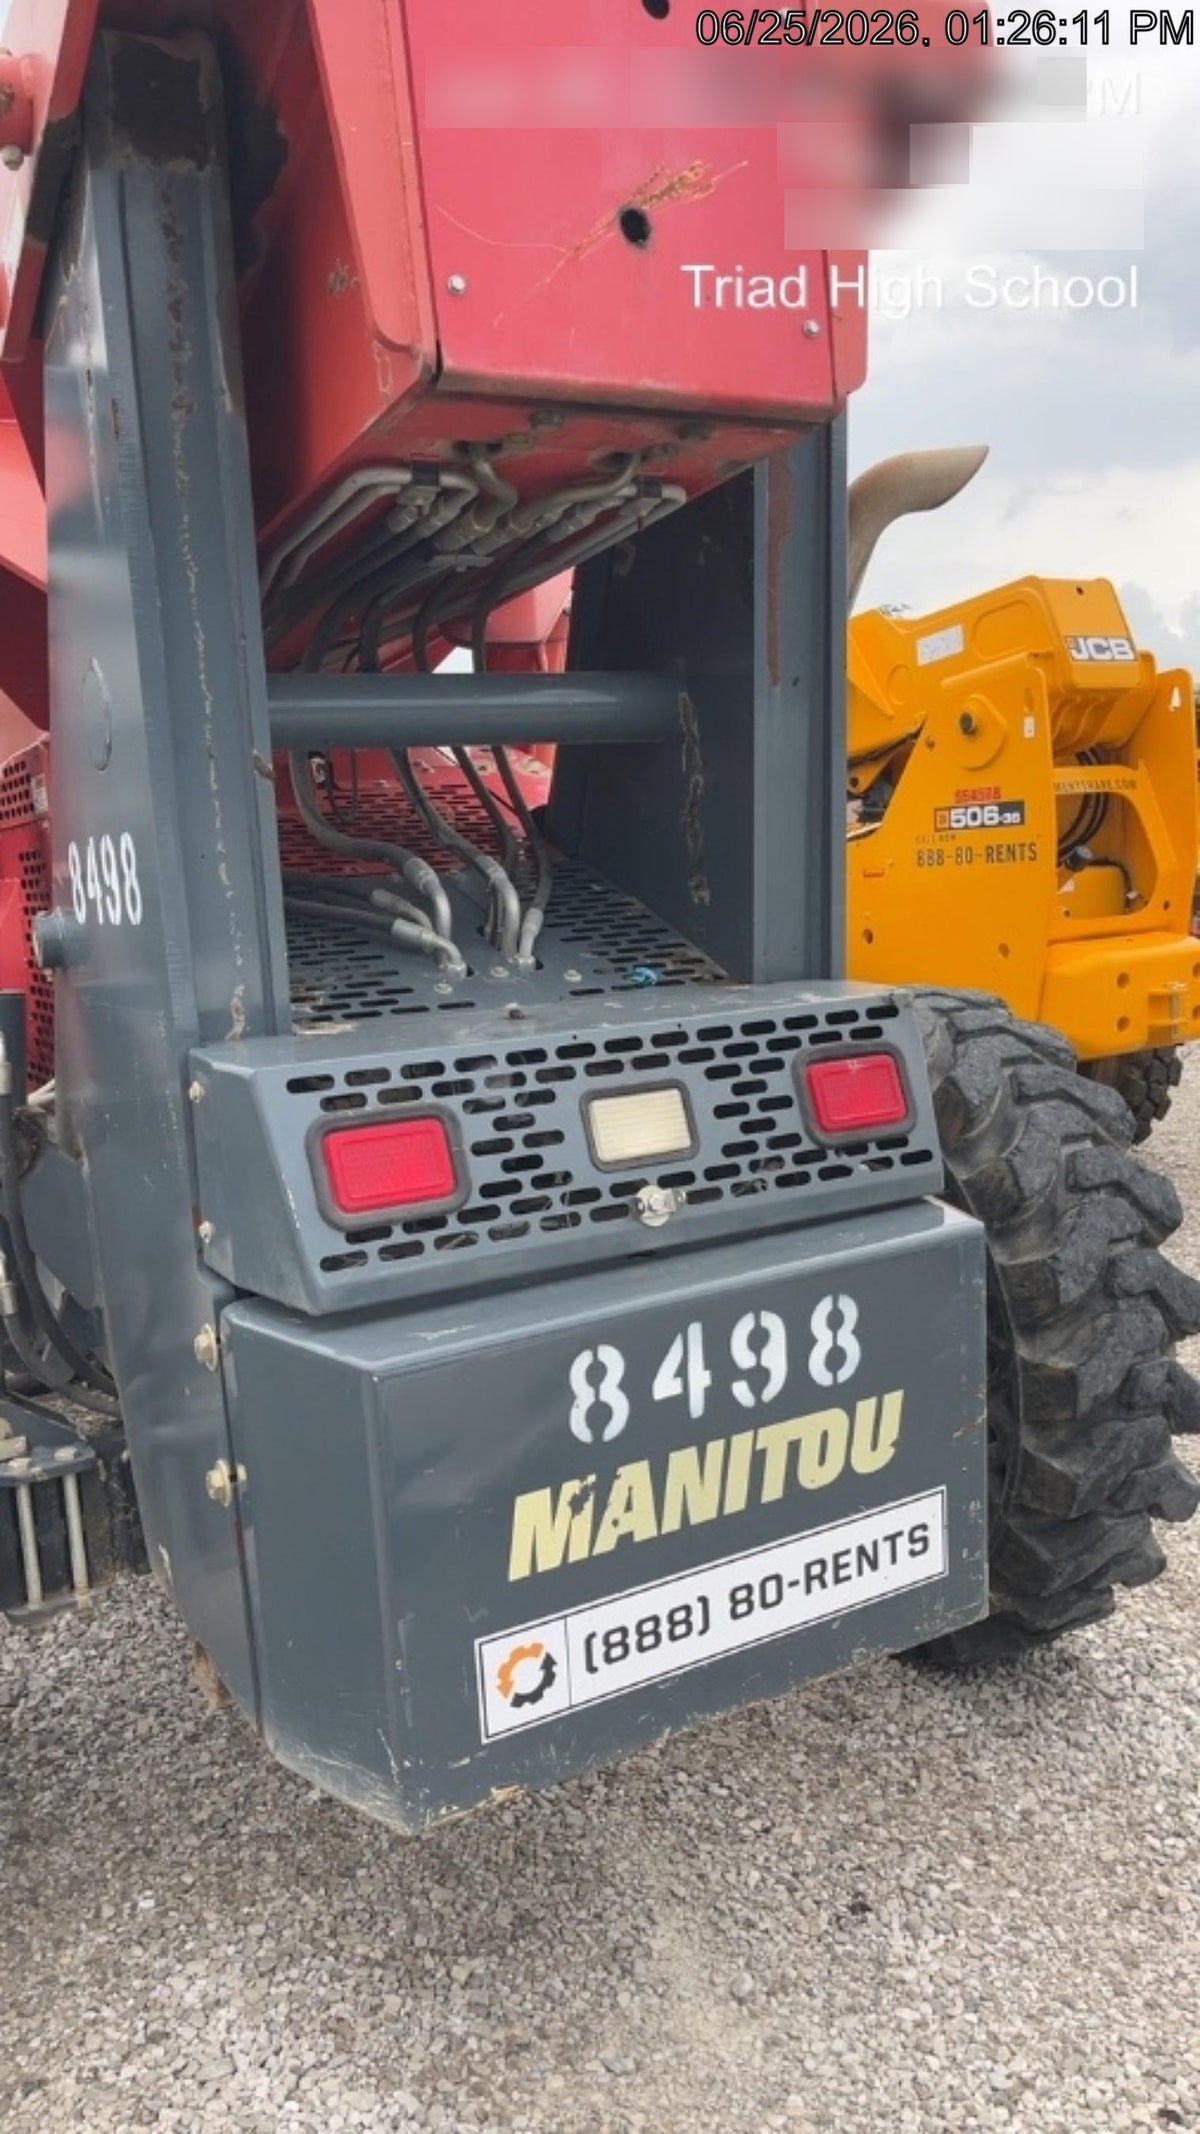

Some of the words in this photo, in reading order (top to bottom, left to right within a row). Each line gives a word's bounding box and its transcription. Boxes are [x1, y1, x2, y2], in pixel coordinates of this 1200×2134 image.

[1071, 636, 1135, 661] JCB
[68, 831, 143, 926] 8498
[917, 841, 1038, 868] 888-80-RENTS
[568, 1293, 862, 1443] 8498
[508, 1389, 904, 1583] MANITOU
[584, 1595, 710, 1675] (888)
[729, 1523, 931, 1621] 80-RENTS
